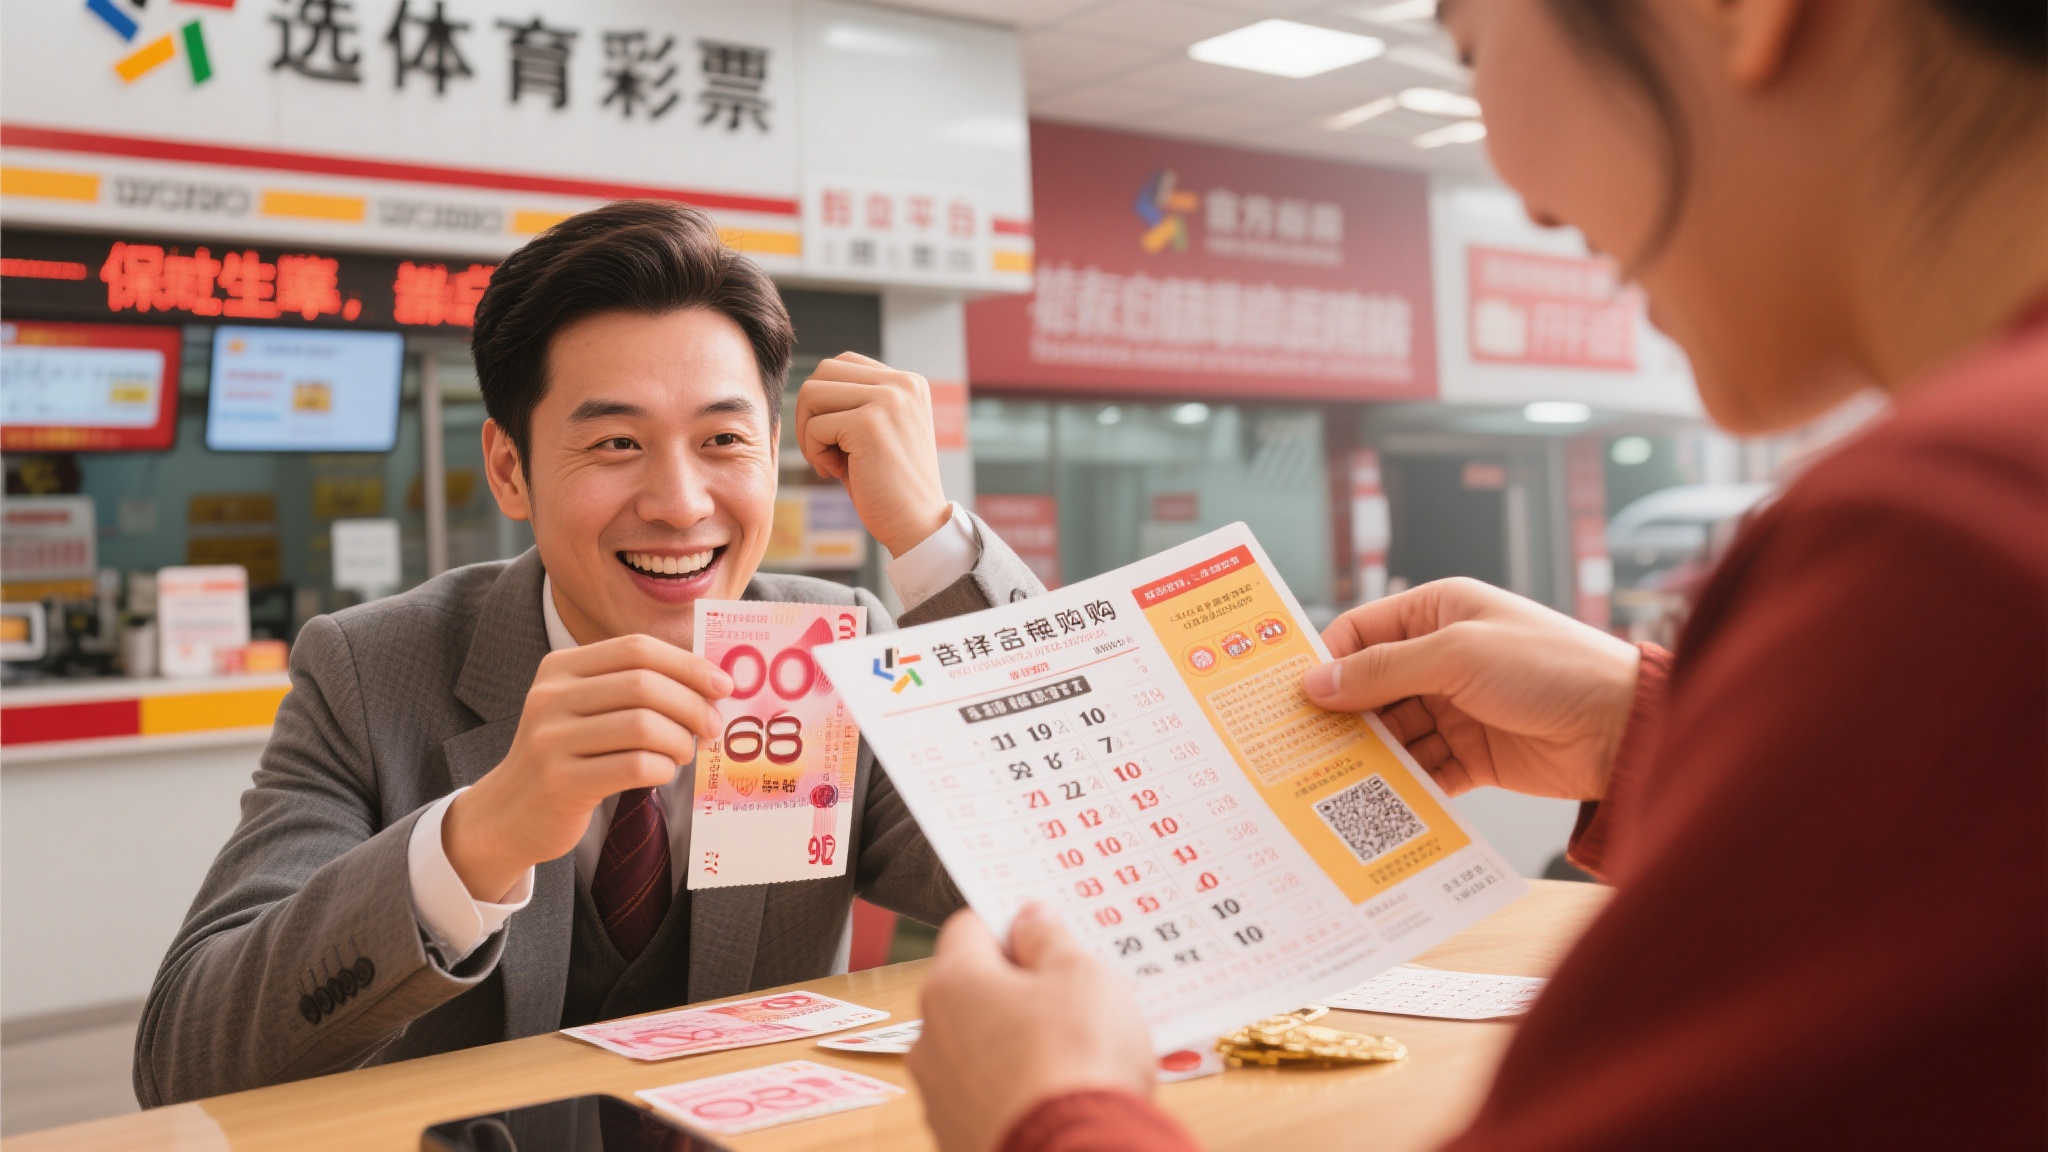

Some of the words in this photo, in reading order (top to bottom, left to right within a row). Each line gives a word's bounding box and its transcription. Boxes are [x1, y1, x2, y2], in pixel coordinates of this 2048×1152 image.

[267, 0, 772, 132] 选体育彩票
[1079, 707, 1107, 727] 10
[1113, 761, 1143, 783] 10
[1055, 848, 1085, 870] 10
[1094, 836, 1122, 858] 10
[1149, 816, 1179, 839] 10
[1211, 897, 1241, 920] 10
[1232, 925, 1264, 947] 10
